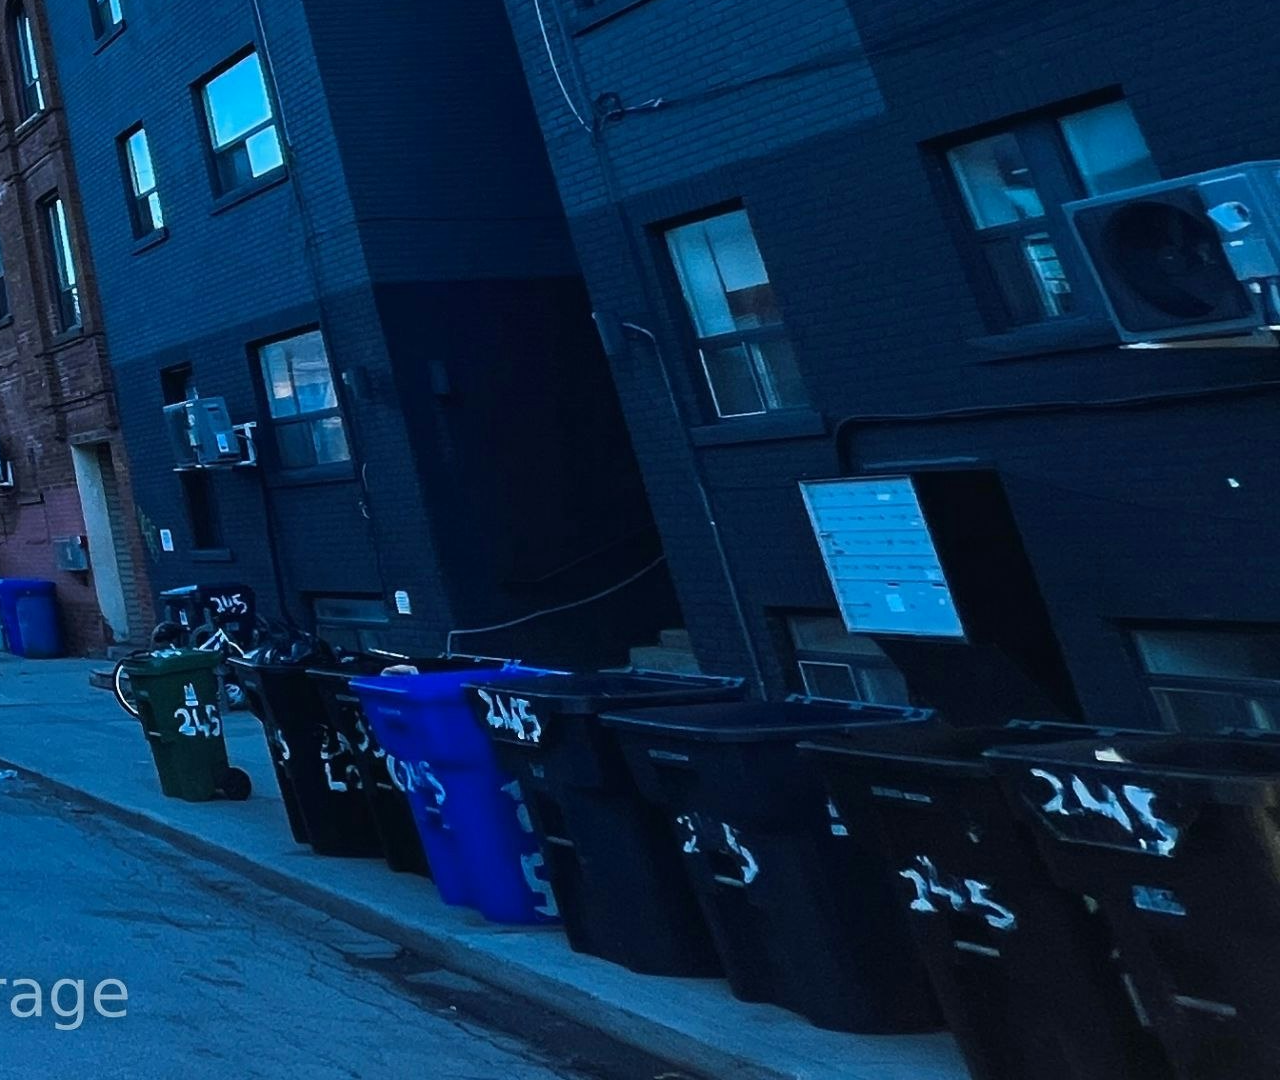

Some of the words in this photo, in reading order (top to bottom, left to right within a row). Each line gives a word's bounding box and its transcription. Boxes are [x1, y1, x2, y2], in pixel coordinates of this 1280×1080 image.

[173, 704, 222, 738] 245
[1029, 767, 1179, 858] 245
[898, 854, 1017, 931] 245
